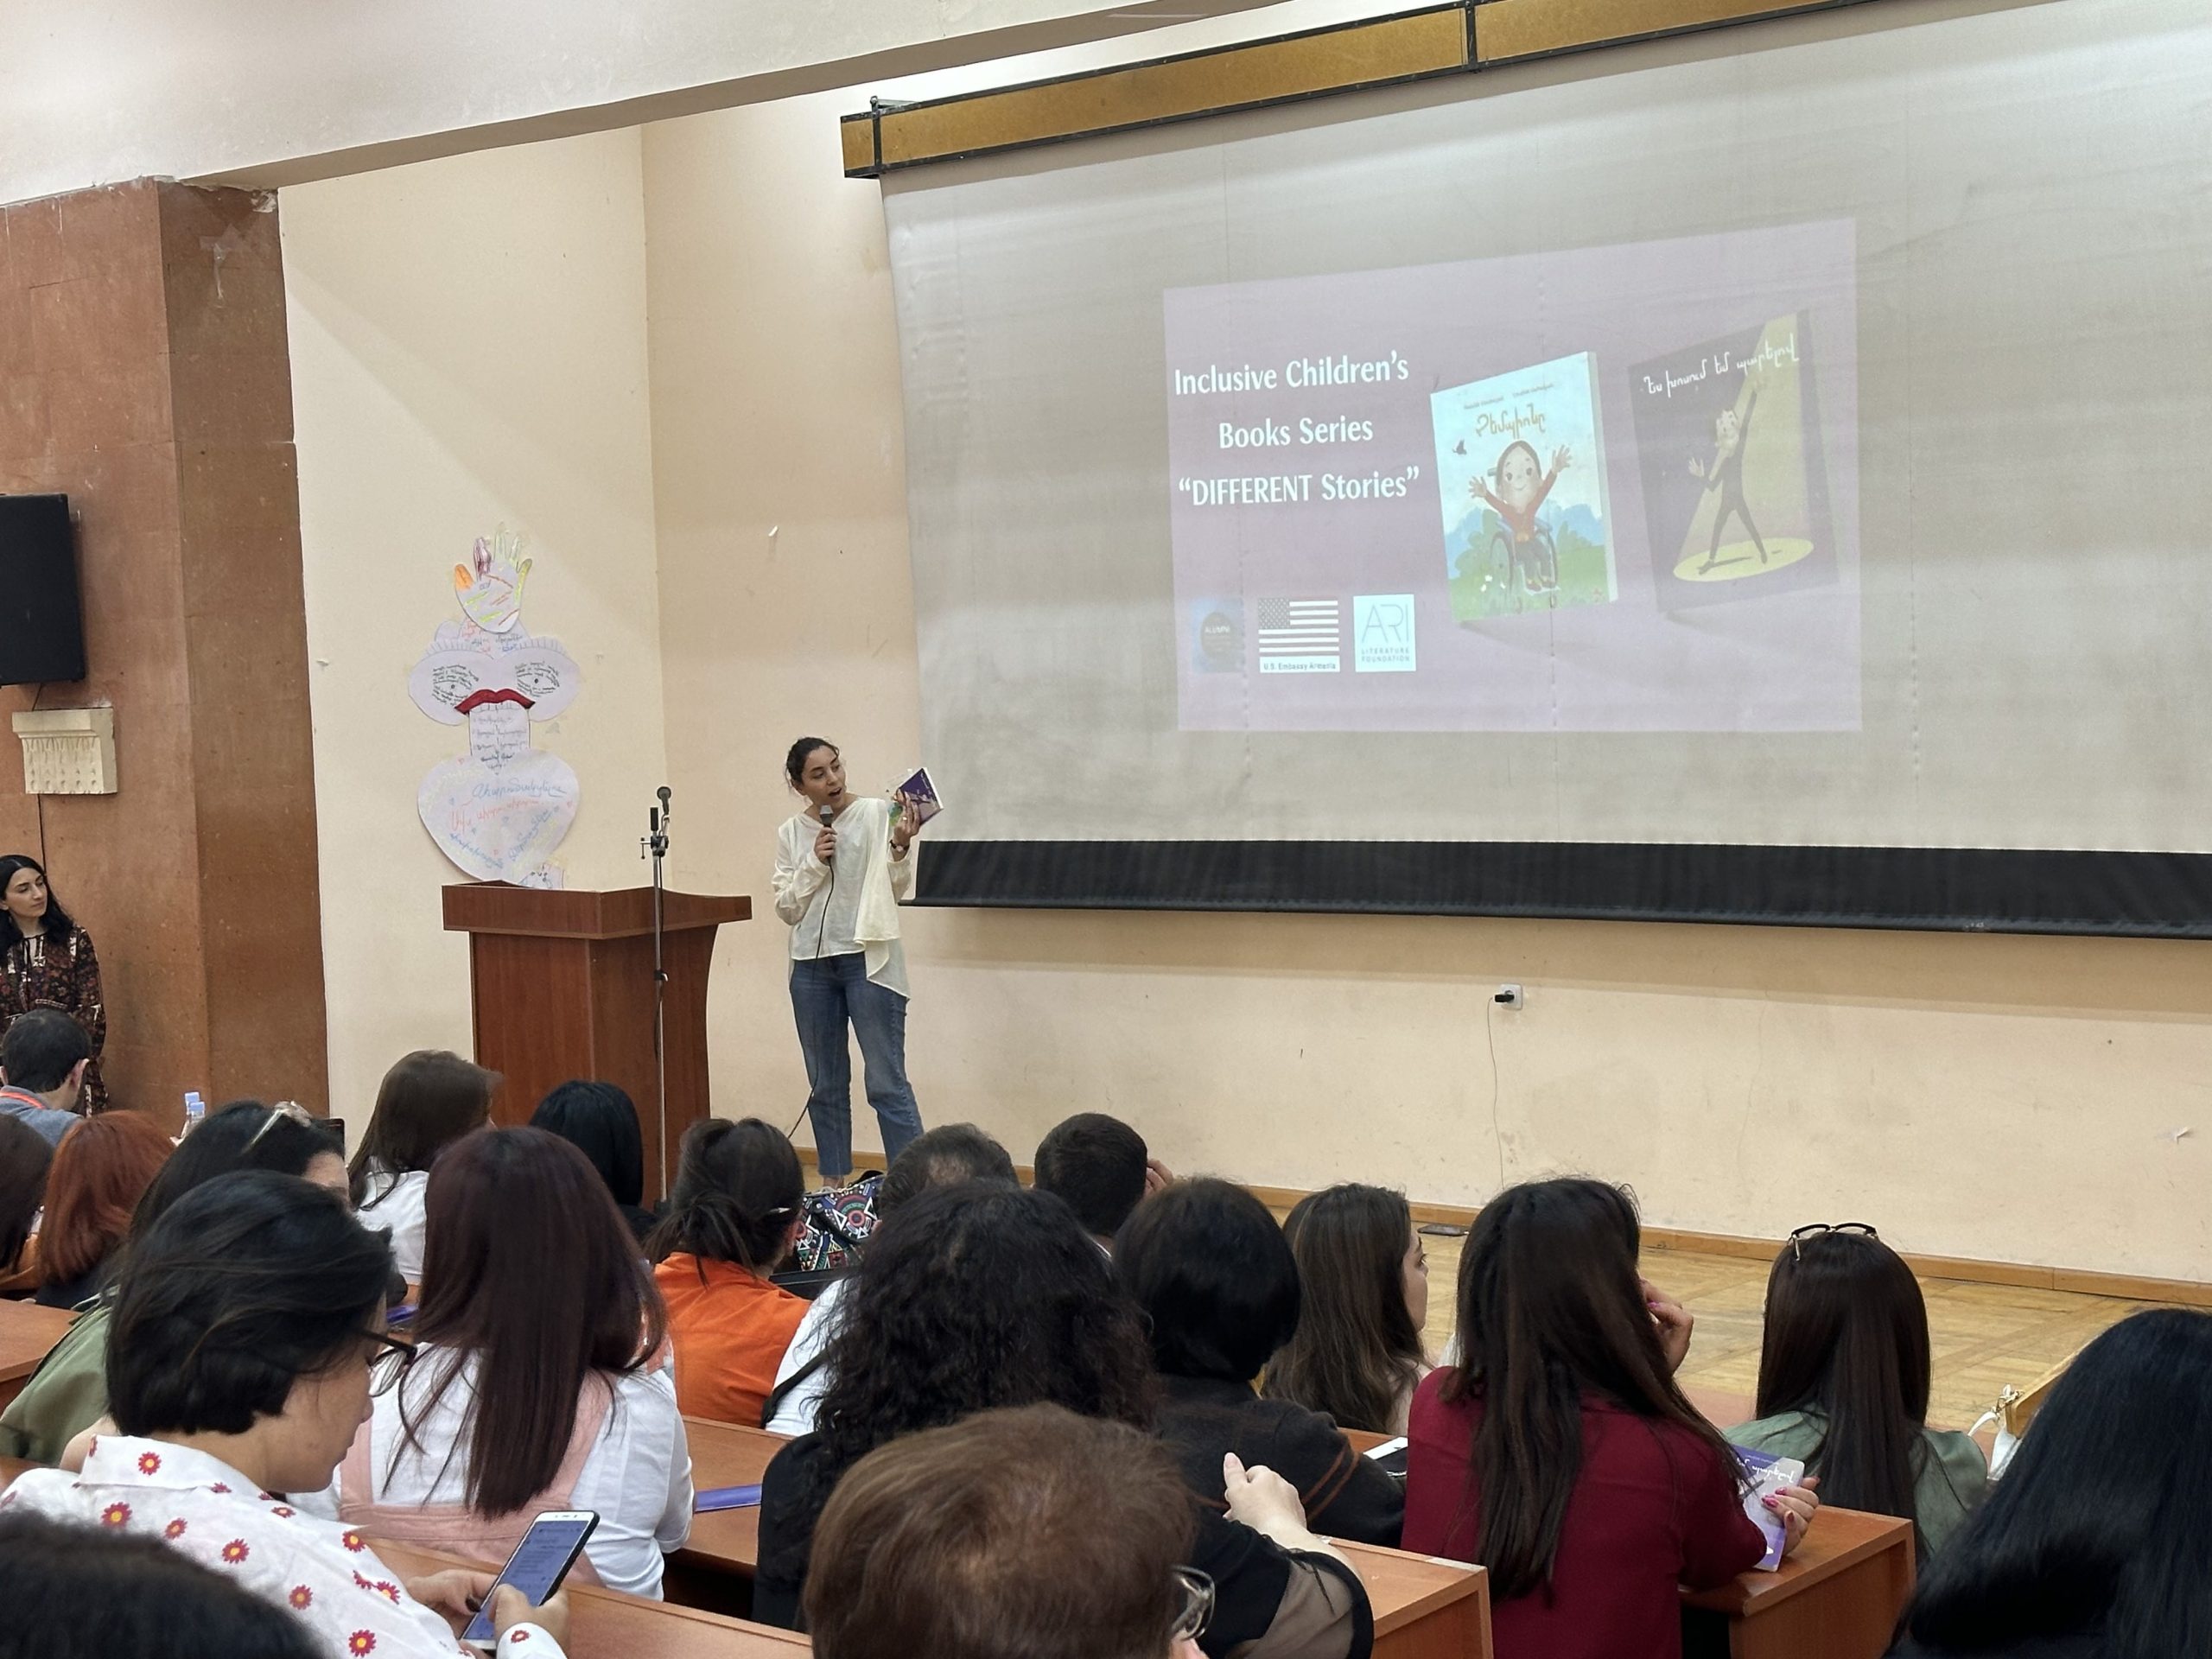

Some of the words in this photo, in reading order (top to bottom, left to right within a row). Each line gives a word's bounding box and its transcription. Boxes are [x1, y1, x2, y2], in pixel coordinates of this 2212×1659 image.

[1174, 364, 1278, 395] Inclusive
[1286, 349, 1409, 388] Children’s
[1643, 376, 1662, 394] Ես
[1665, 359, 1707, 398] խոսում
[1714, 351, 1730, 375] եմ
[1736, 332, 1800, 377] պարելով
[1218, 418, 1291, 448] Books
[1299, 415, 1373, 444] Series
[1475, 402, 1546, 439] Չեմպիոնը
[1178, 474, 1313, 505] “DIFFERENT
[1321, 465, 1420, 500] Stories”
[1361, 603, 1409, 643] ARI
